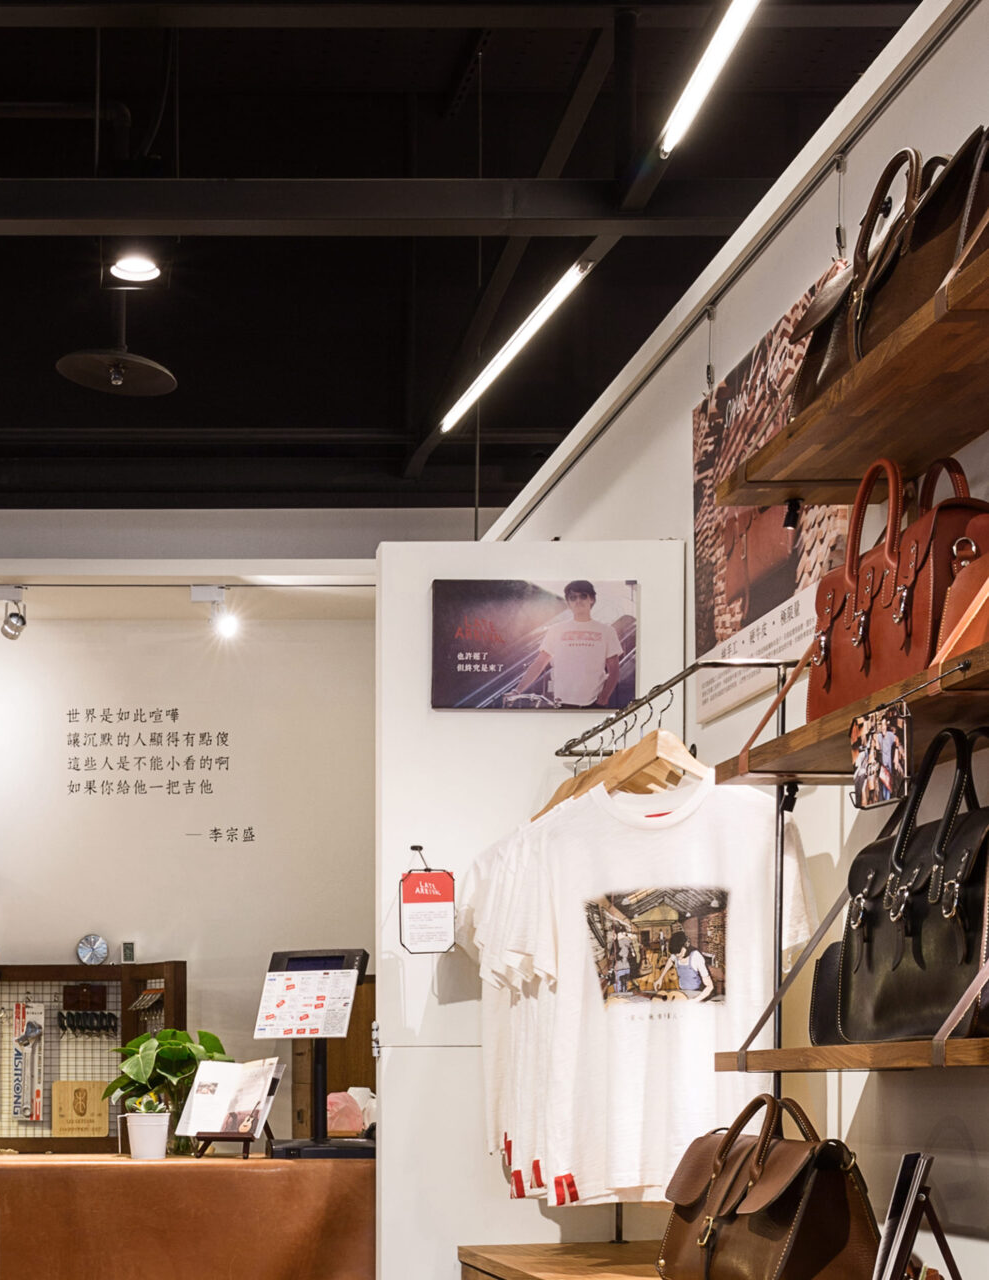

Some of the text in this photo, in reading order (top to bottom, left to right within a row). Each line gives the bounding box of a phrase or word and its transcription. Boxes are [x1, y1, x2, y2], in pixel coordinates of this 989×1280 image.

[66, 708, 180, 723] 世界是如此喧嘩
[66, 731, 229, 748] 讓沉默的人顯得有點傻
[67, 755, 230, 772] 這些人是不能小看的啊
[67, 779, 214, 796] 如果你給他一把吉他
[209, 826, 256, 843] 李宗盛
